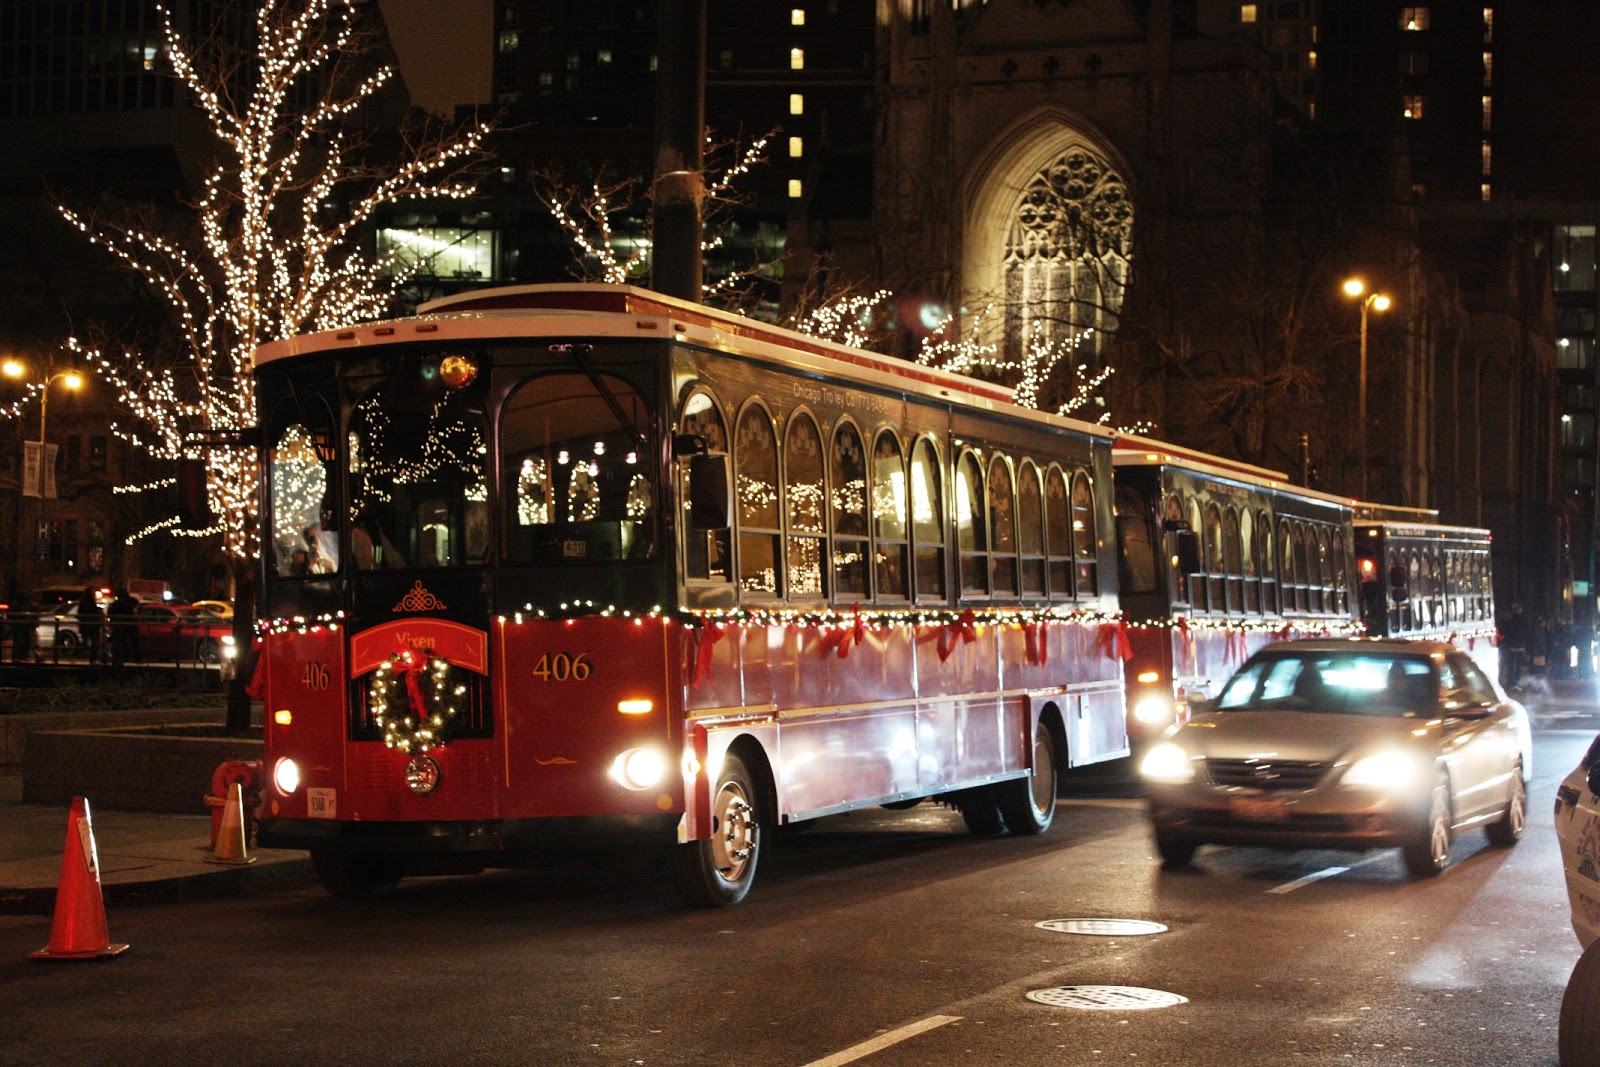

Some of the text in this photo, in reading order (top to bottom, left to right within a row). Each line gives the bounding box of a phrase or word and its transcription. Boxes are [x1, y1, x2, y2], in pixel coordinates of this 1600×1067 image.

[793, 382, 821, 404] Chicago
[822, 387, 844, 408] Trolley
[396, 633, 435, 649] Vixen
[302, 661, 329, 690] 406
[532, 652, 591, 682] 406
